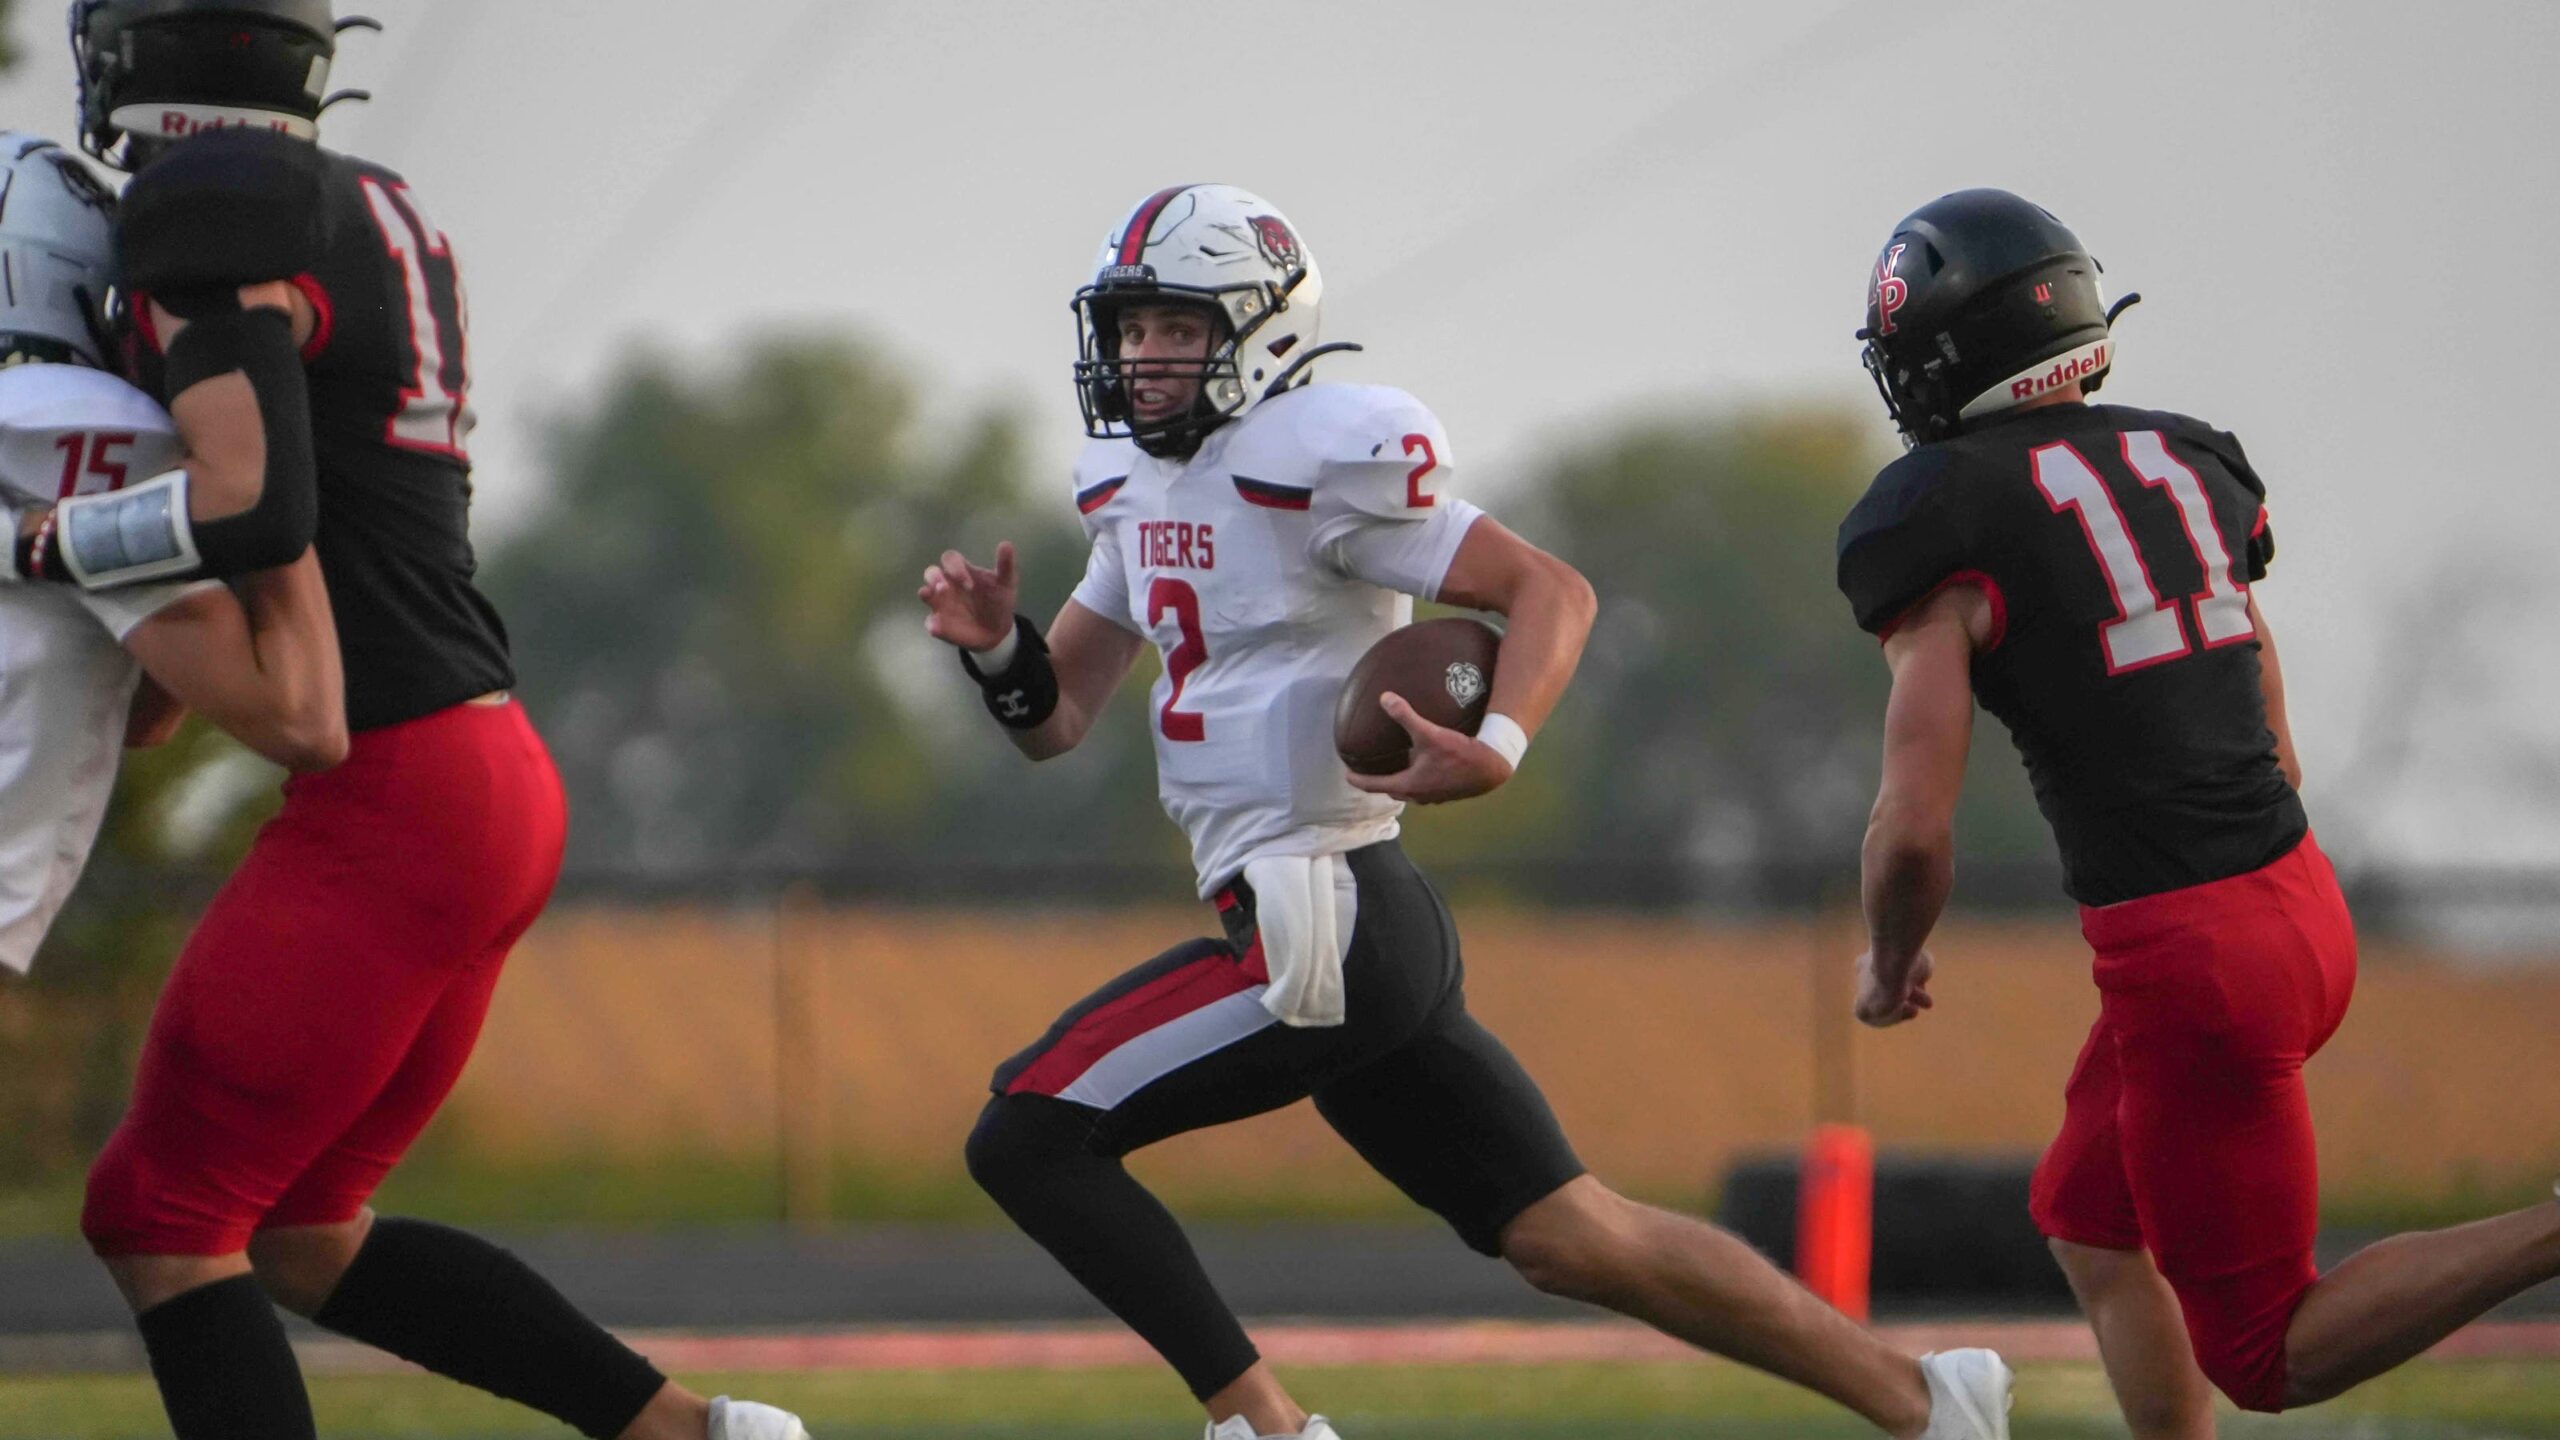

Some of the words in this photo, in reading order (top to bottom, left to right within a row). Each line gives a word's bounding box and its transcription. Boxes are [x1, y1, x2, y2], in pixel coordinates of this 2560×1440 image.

[1102, 264, 1144, 279] TIGERS
[2011, 345, 2106, 400] Riddell
[55, 430, 136, 501] 15
[1401, 433, 1437, 509] 2
[1138, 520, 1214, 570] TIGERS
[2029, 429, 2256, 676] 11
[1147, 576, 1209, 742] 2
